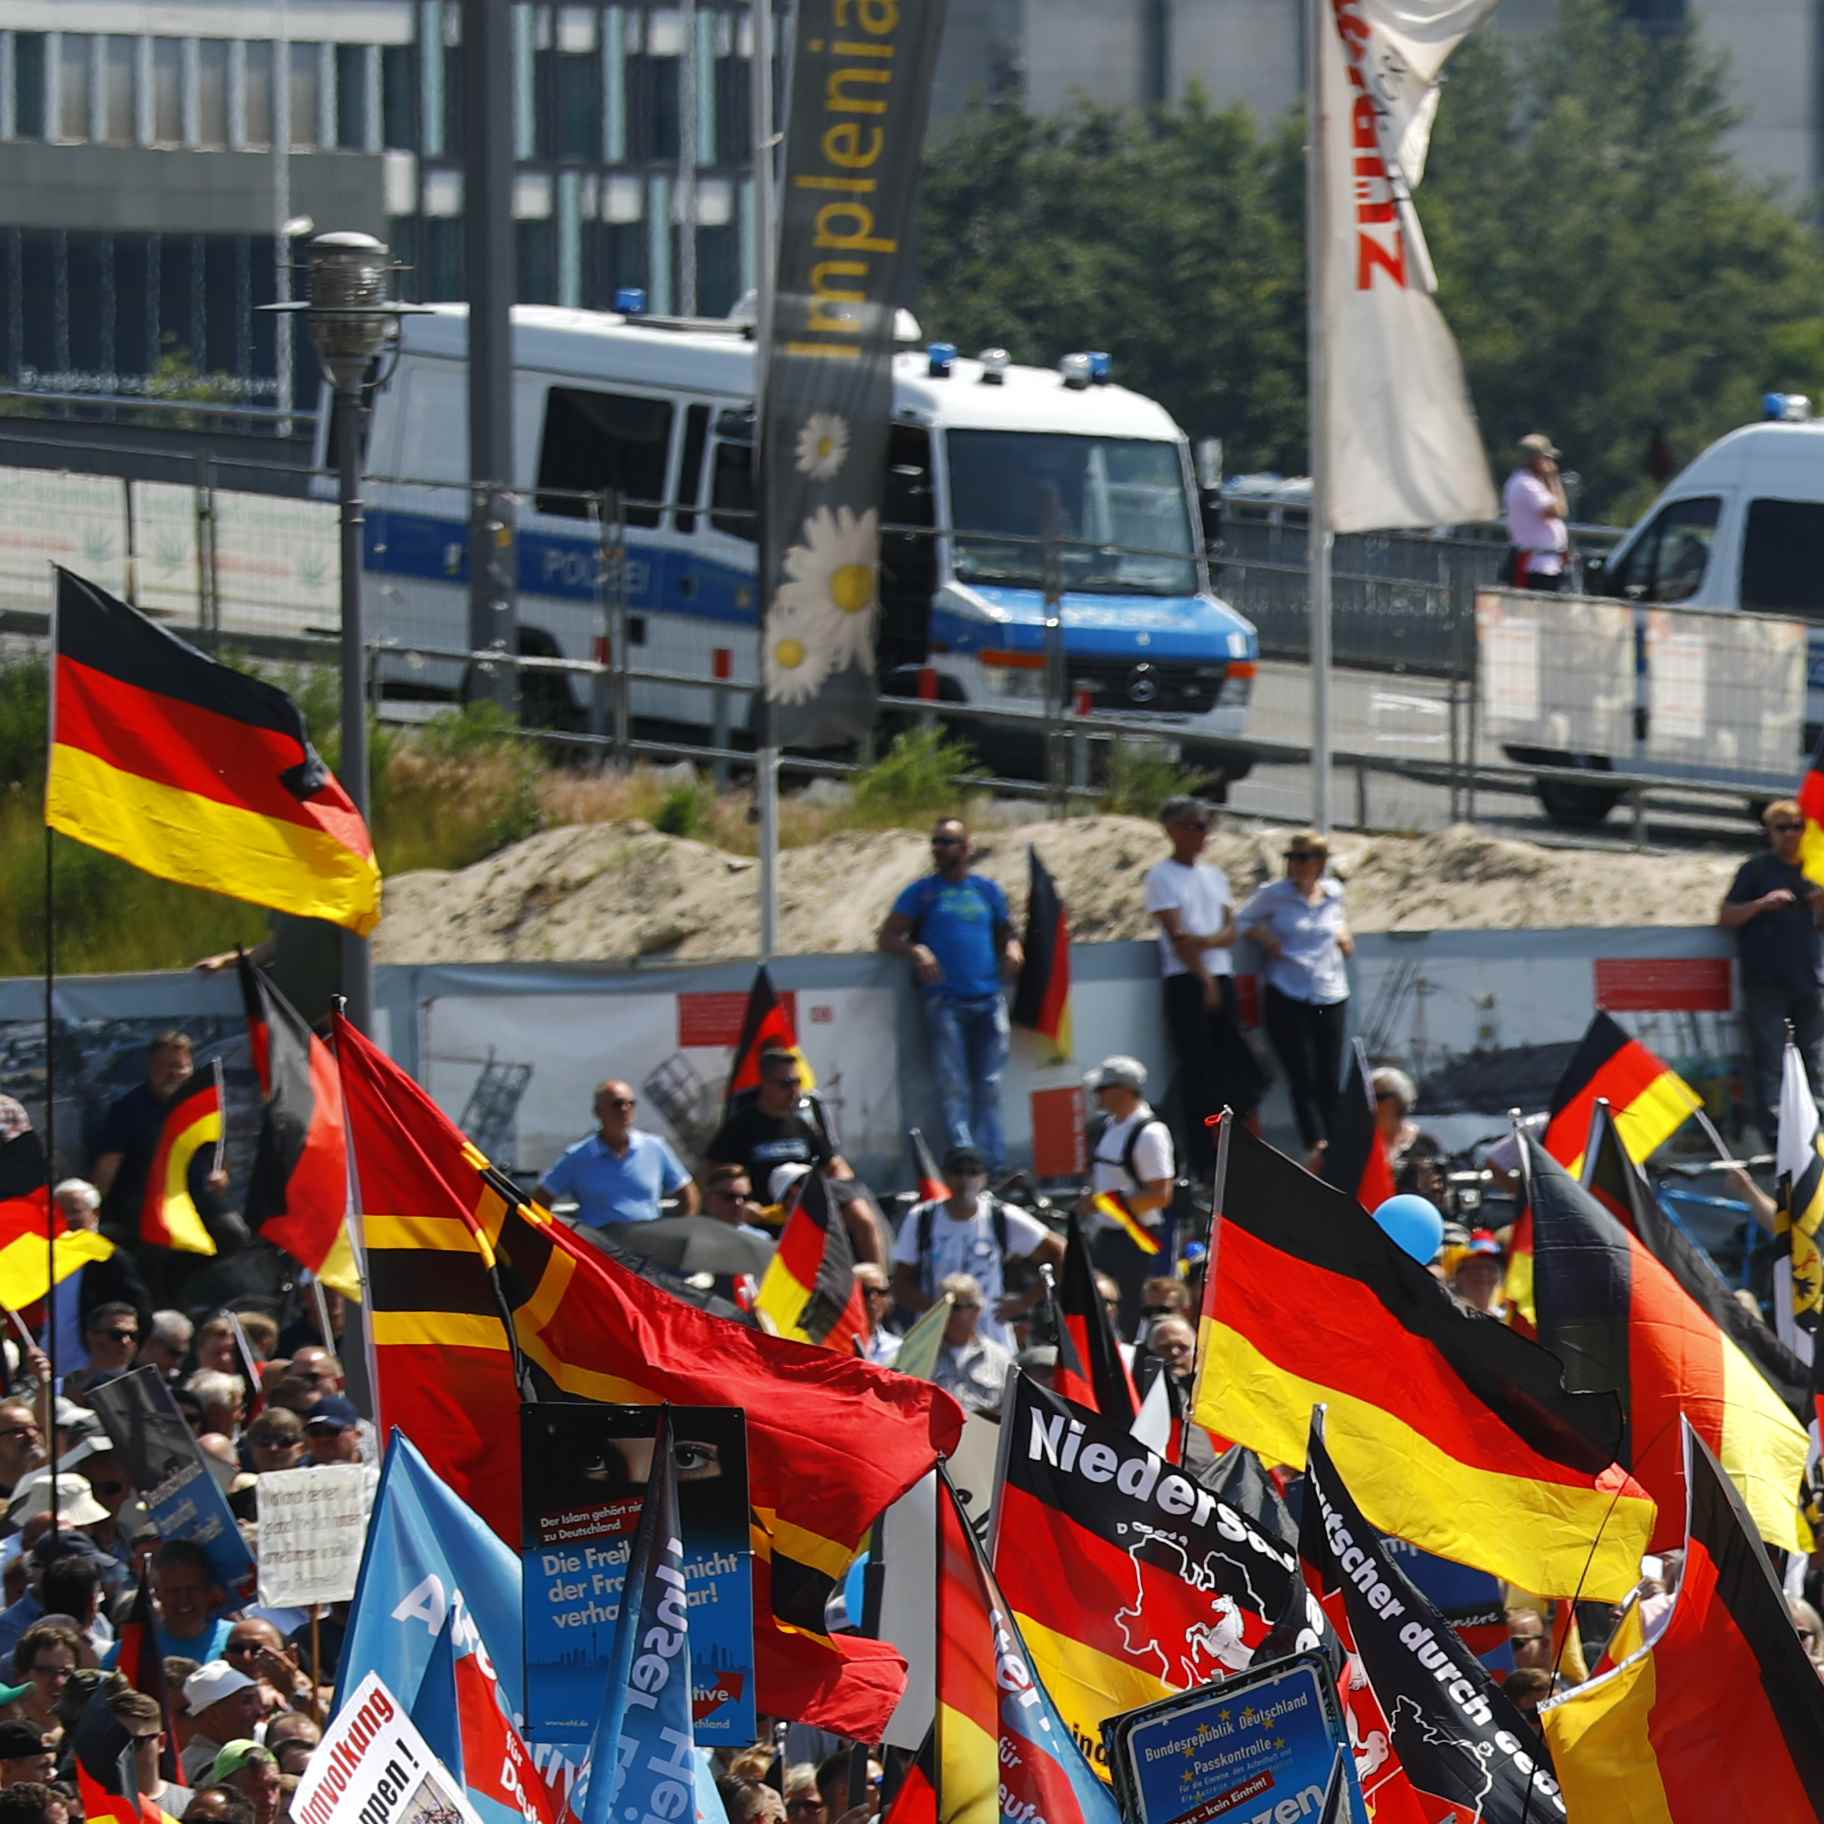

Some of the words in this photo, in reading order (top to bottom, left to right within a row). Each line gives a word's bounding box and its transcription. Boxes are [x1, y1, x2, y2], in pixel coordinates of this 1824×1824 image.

[785, 0, 899, 358] Implenia
[544, 1531, 557, 1542] zu
[558, 1518, 622, 1540] Deutschland
[560, 1509, 590, 1526] Islam
[591, 1502, 626, 1523] gehört
[542, 1553, 581, 1577] Die
[548, 1578, 586, 1604] der
[683, 1551, 739, 1580] nicht
[1399, 1621, 1492, 1727] durch
[1144, 1720, 1235, 1763] Bundesrepublik
[1239, 1691, 1309, 1730] Deutschland
[1193, 1736, 1273, 1776] Passkontrolle
[1207, 1797, 1230, 1819] kein
